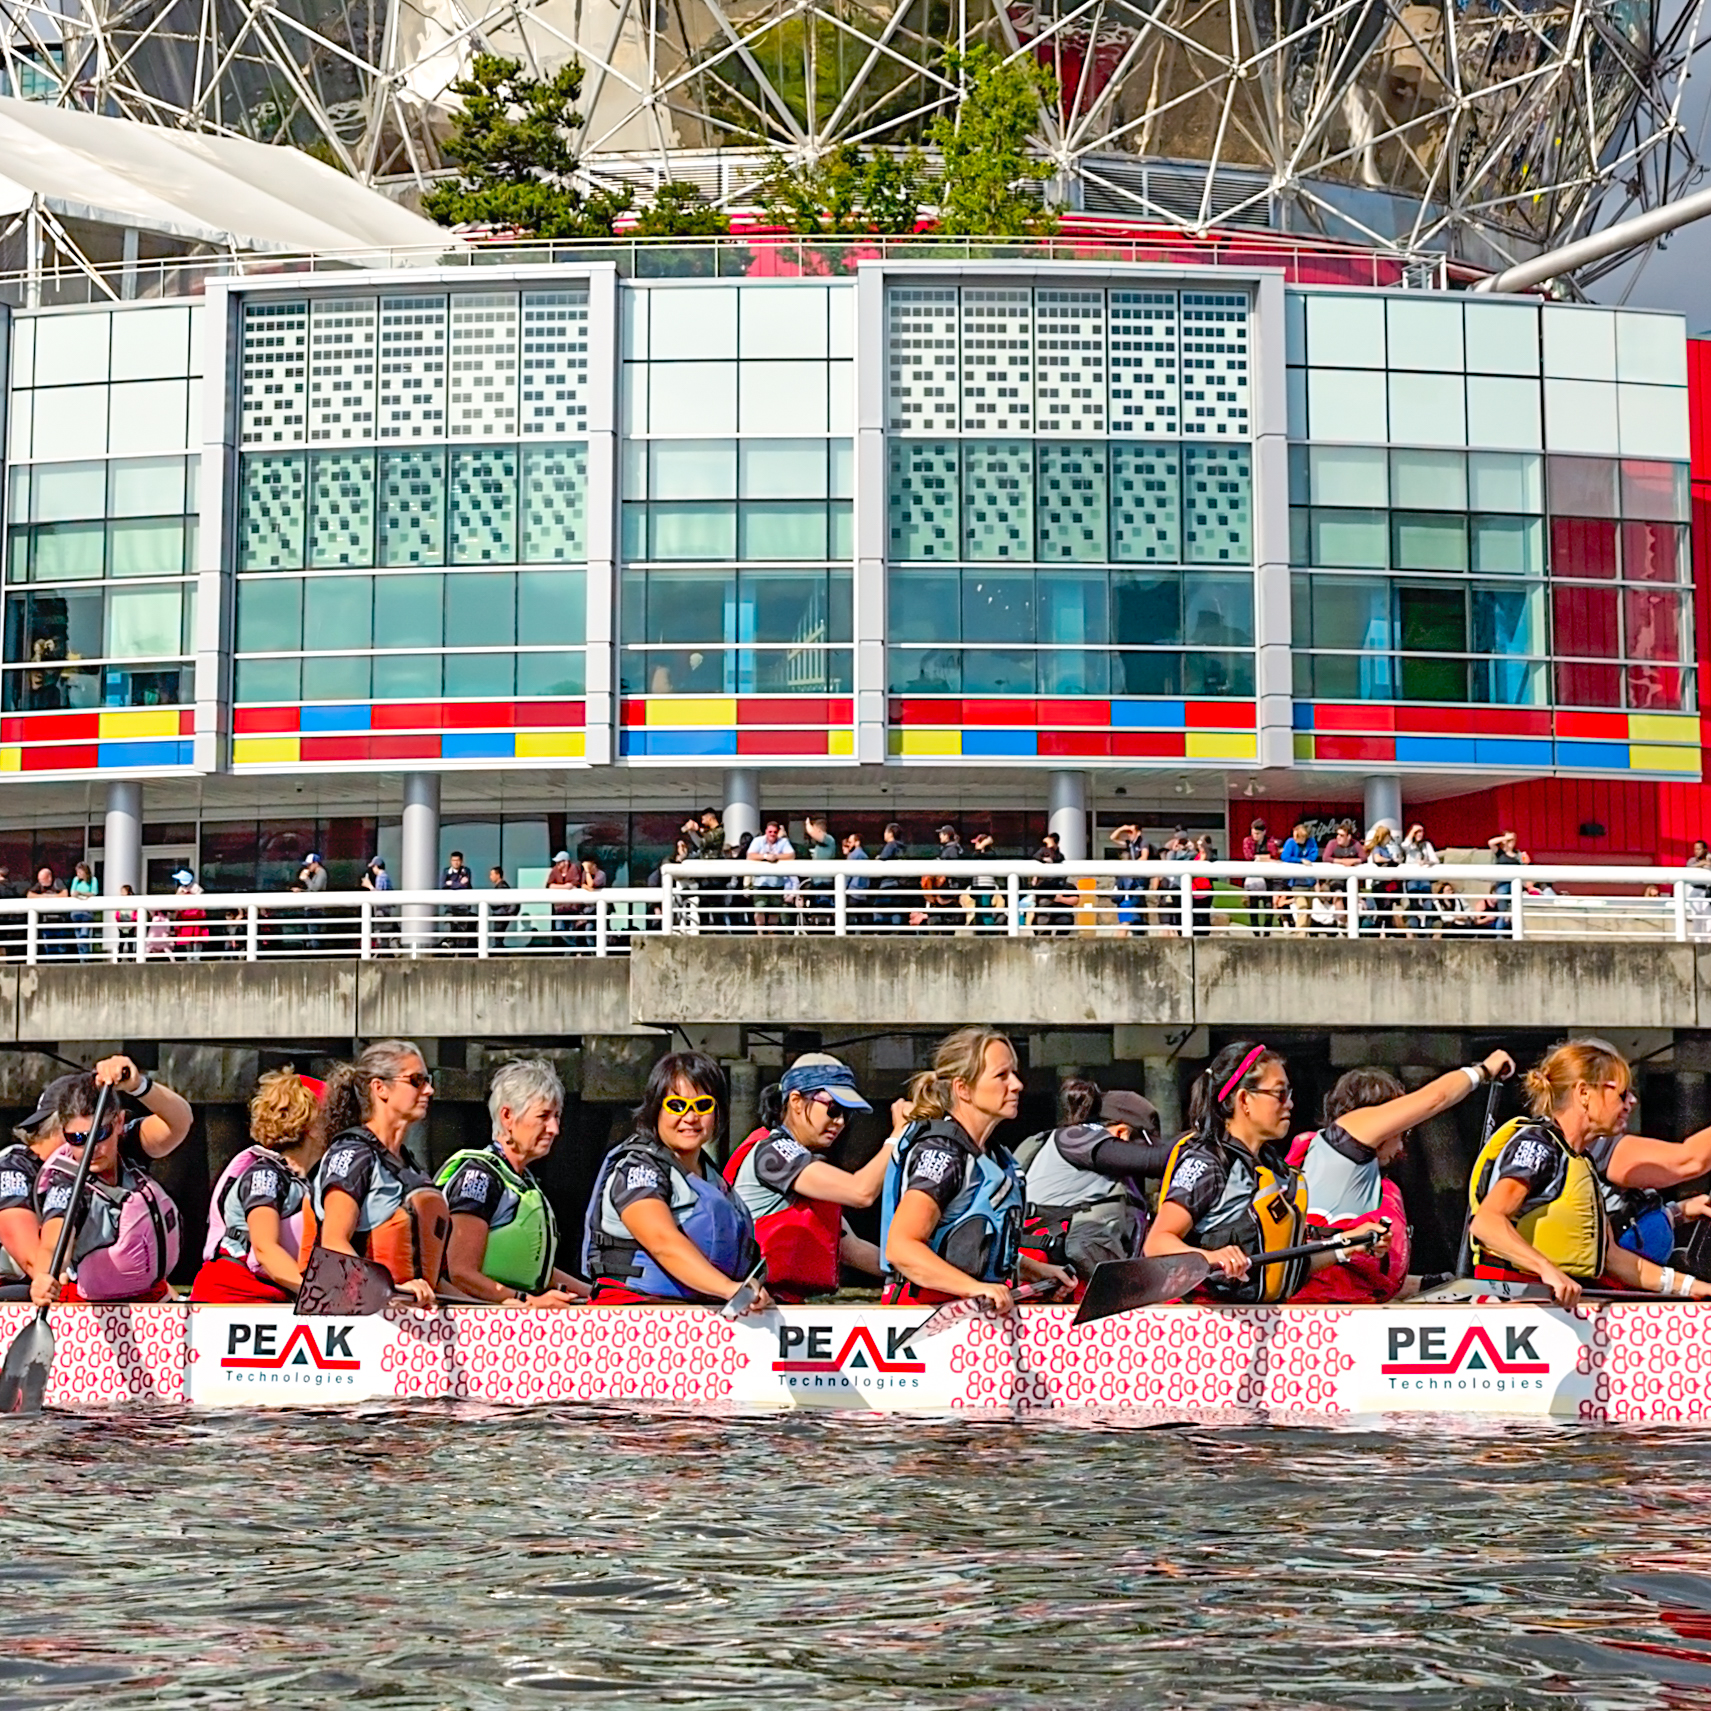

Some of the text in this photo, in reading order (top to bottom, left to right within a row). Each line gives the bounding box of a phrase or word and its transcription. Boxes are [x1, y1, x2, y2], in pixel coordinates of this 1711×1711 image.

[1519, 1140, 1550, 1158] FALSE
[227, 1323, 355, 1362] PEAK
[778, 1325, 918, 1364] PEAK
[1388, 1325, 1540, 1366] PEAK
[225, 1370, 355, 1386] Technologies
[778, 1374, 920, 1389] Technologies
[1388, 1377, 1544, 1391] Technologies
